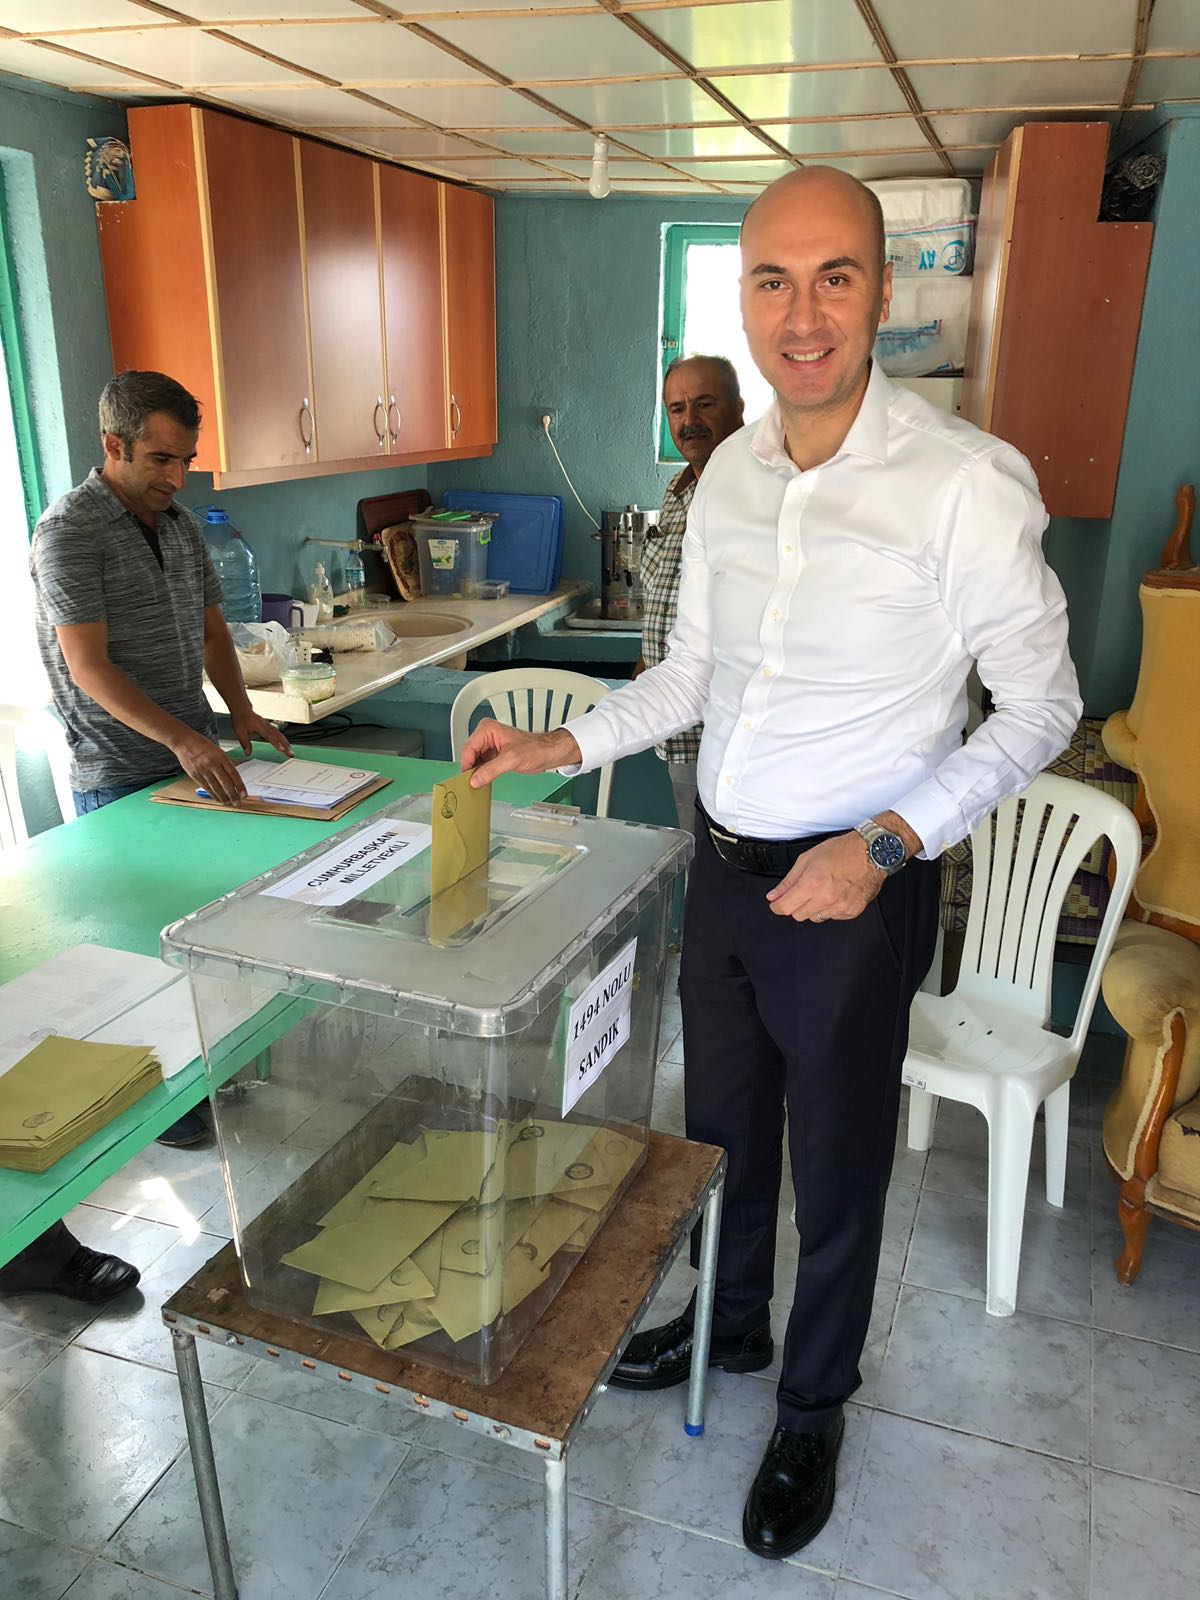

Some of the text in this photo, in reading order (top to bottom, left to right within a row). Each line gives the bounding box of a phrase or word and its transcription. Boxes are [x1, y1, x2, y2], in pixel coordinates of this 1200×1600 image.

[573, 962, 632, 1042] 1494 NOLU
[578, 1017, 620, 1080] SANDIK
